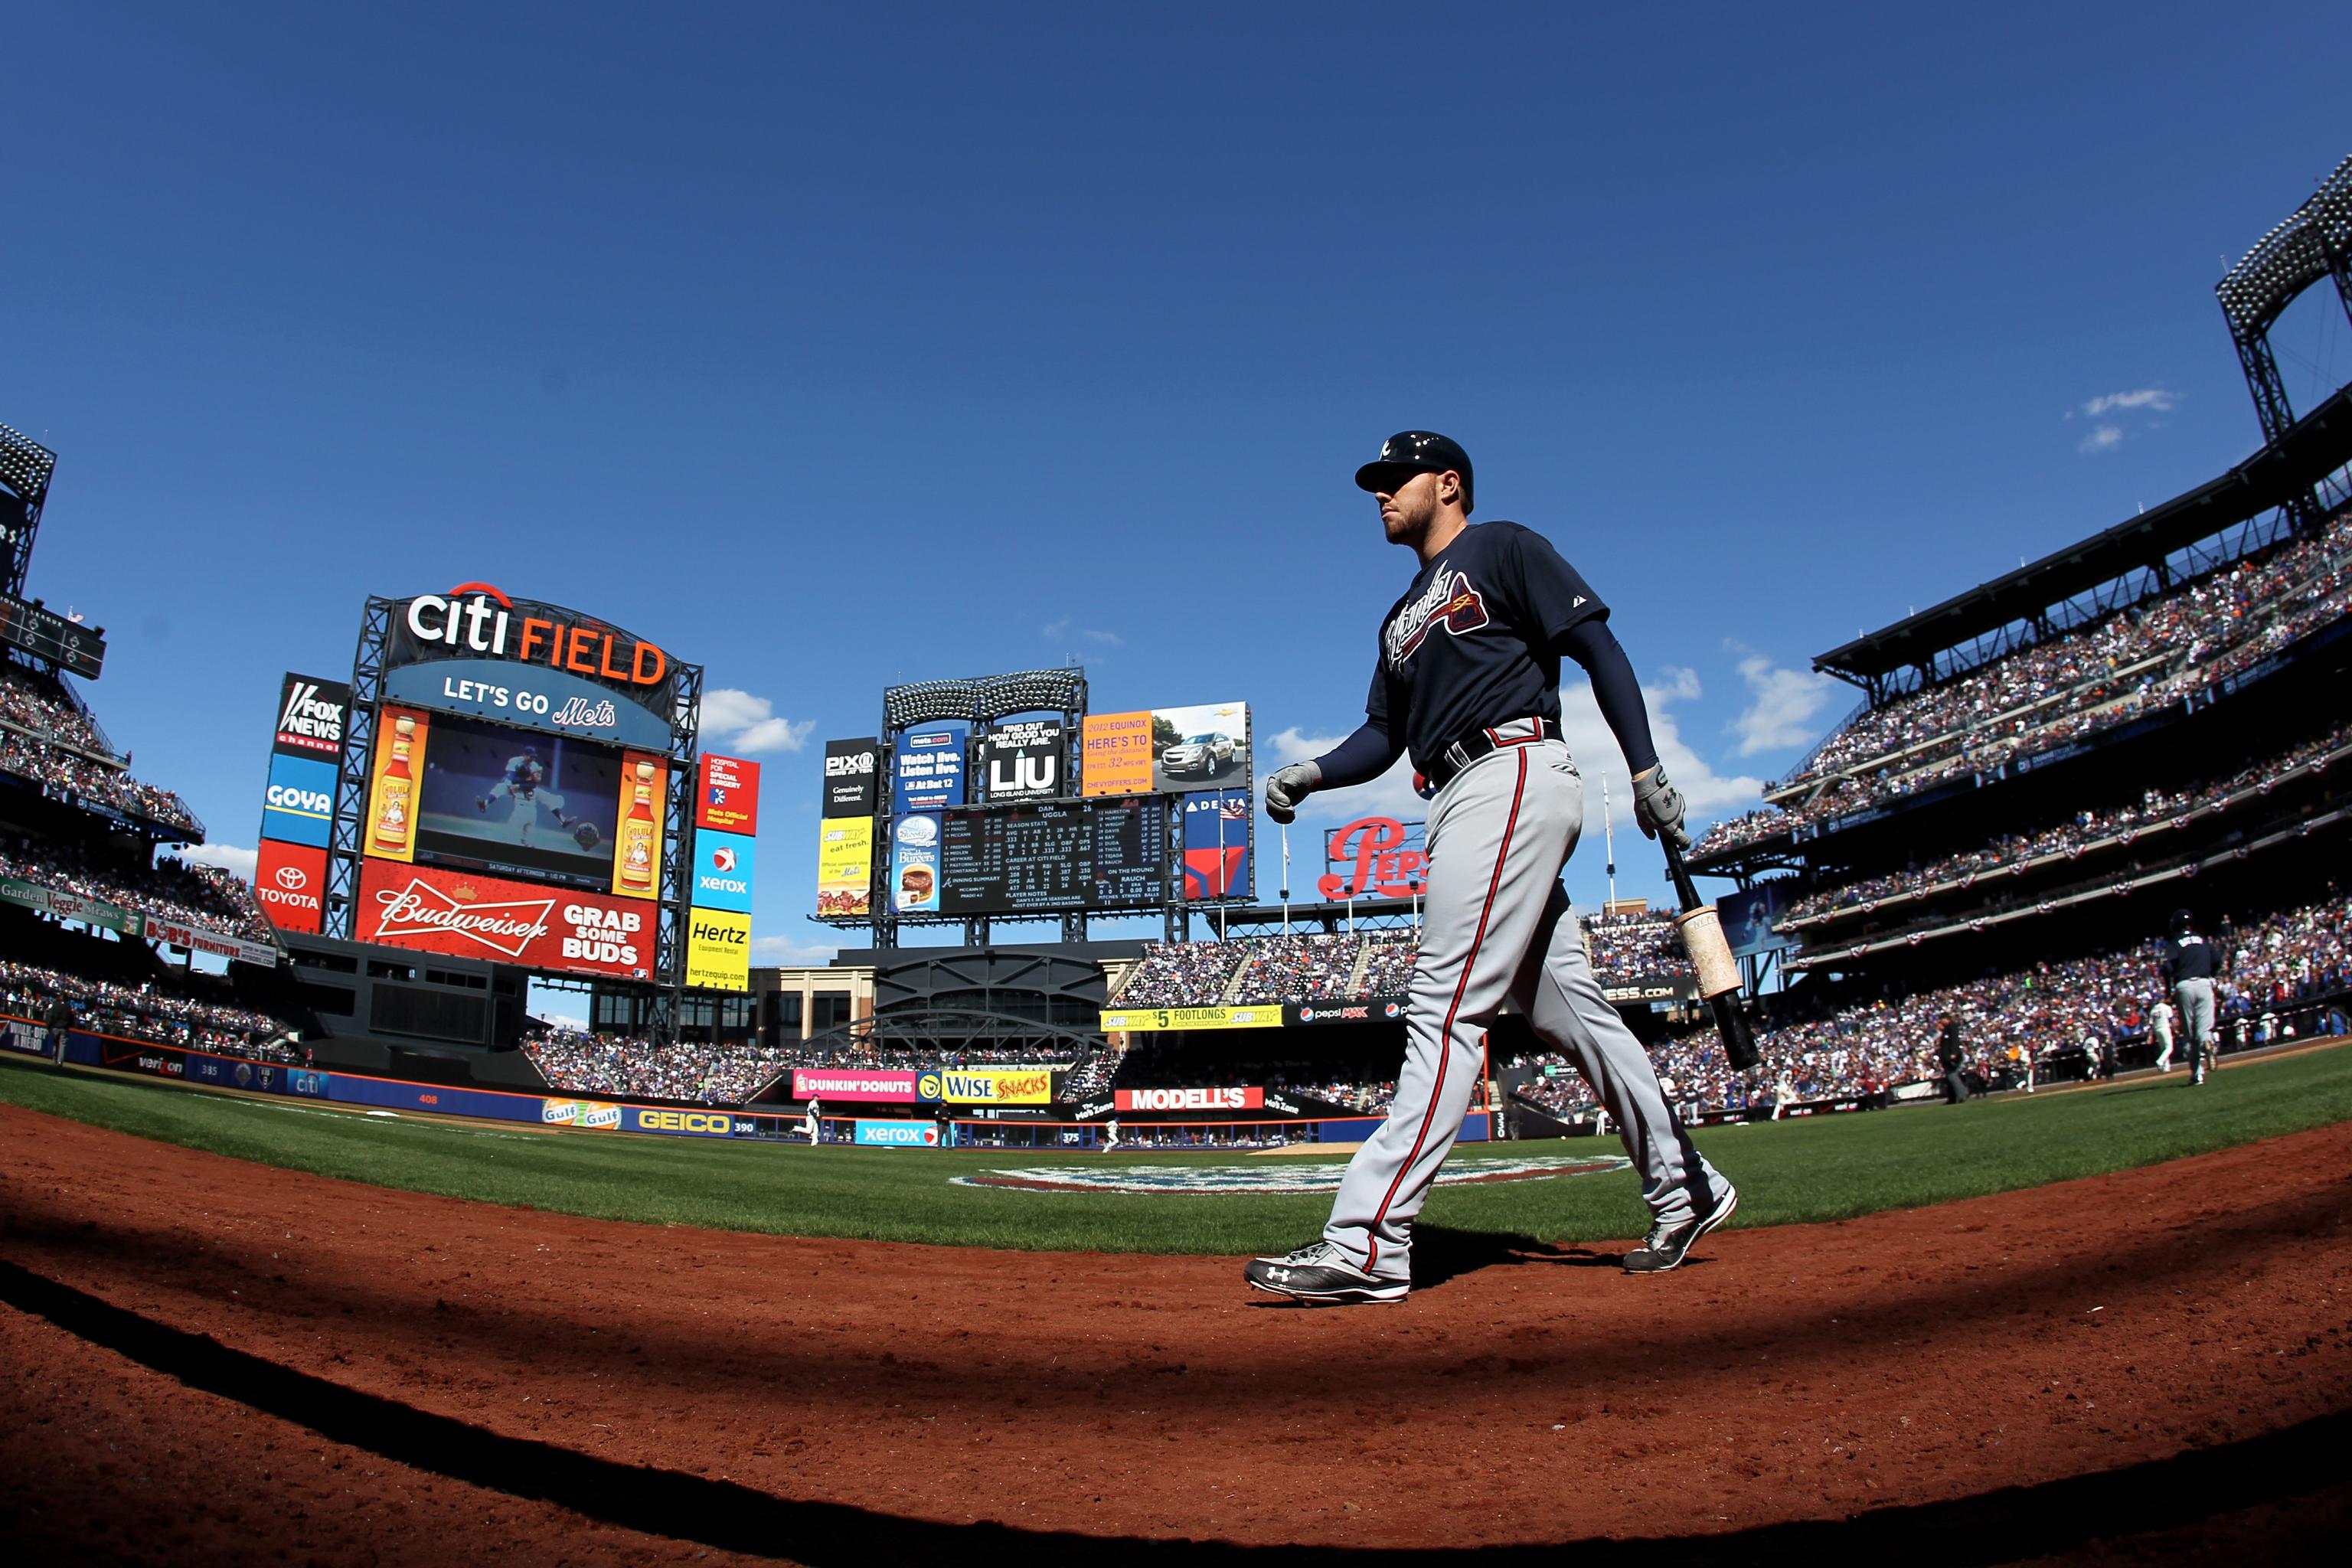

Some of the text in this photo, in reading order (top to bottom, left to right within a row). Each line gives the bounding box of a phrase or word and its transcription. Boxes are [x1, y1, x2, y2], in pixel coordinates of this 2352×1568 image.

[31, 609, 62, 627] LEAGUE
[520, 616, 666, 684] FIELD
[443, 677, 616, 727] LET'S GO Mets
[302, 697, 344, 724] FOX
[288, 715, 341, 740] NEWS
[1002, 722, 1044, 733] FIND OUT
[1088, 720, 1146, 733] 2012 EQUINOX
[913, 736, 949, 745] mets.com
[988, 728, 1060, 742] HOW GOOD YOU
[1087, 734, 1147, 750] HERE'S TO
[279, 735, 339, 752] channel
[995, 737, 1051, 749] REALLY ARE.
[710, 757, 739, 769] HOSPITAL
[900, 751, 961, 766] Watch live.
[1108, 756, 1123, 768] 32
[710, 771, 737, 781] SPECIAL
[900, 763, 959, 778] Listen live.
[990, 755, 1055, 792] LIU
[709, 778, 741, 789] SURGERY
[832, 785, 864, 794] Genuinely
[915, 778, 953, 790] At Bat 12
[1086, 778, 1147, 789] CHEVYOFFERS.COM
[267, 785, 332, 813] GOYA
[1024, 788, 1054, 796] UNIVERSITY
[1200, 798, 1246, 810] DETA
[707, 815, 735, 825] Hospital
[724, 811, 748, 821] Official
[824, 828, 866, 842] SUBWAY
[830, 840, 869, 853] eat fresh.
[488, 863, 515, 872] SATURDAY
[516, 867, 546, 877] AFTERNOON
[841, 866, 860, 877] Mets
[700, 875, 746, 894] xerox
[1, 884, 120, 920] Garden Veggie Straws
[259, 887, 319, 910] TOYOTA
[376, 889, 550, 939] Budweiser
[563, 904, 641, 932] GRAB
[576, 926, 627, 944] SOME
[692, 923, 746, 945] Hertz
[192, 937, 240, 958] FURNITURE
[562, 937, 639, 965] BUDS
[698, 943, 723, 954] Equipment
[690, 968, 745, 982] hertzequip.com
[1604, 986, 1674, 1001] ESS.COM
[1104, 1014, 1150, 1028] SUBWAY
[1152, 1011, 1169, 1028] $5
[1174, 1008, 1226, 1021] FOOTLONGS
[1230, 1009, 1279, 1024] SUBWAY
[1315, 1006, 1369, 1019] pepsi MAX
[9, 1021, 48, 1039] WALK-OFF
[13, 1035, 42, 1050] A HERO
[139, 1057, 183, 1073] verizon
[201, 1064, 217, 1076] 335
[861, 1080, 912, 1093] DONUTS
[946, 1073, 1047, 1102] WISE SNACKS
[419, 1094, 438, 1105] 408
[1131, 1087, 1246, 1109] MODELL'S
[1273, 1093, 1283, 1102] The
[1075, 1102, 1115, 1121] Mo's Zone
[1265, 1098, 1299, 1114] Mo's Zone
[544, 1103, 619, 1125] Gulf Gulf
[639, 1110, 730, 1134] GEICO
[734, 1122, 753, 1132] 390
[864, 1127, 919, 1142] xerox
[1063, 1132, 1080, 1142] 375
